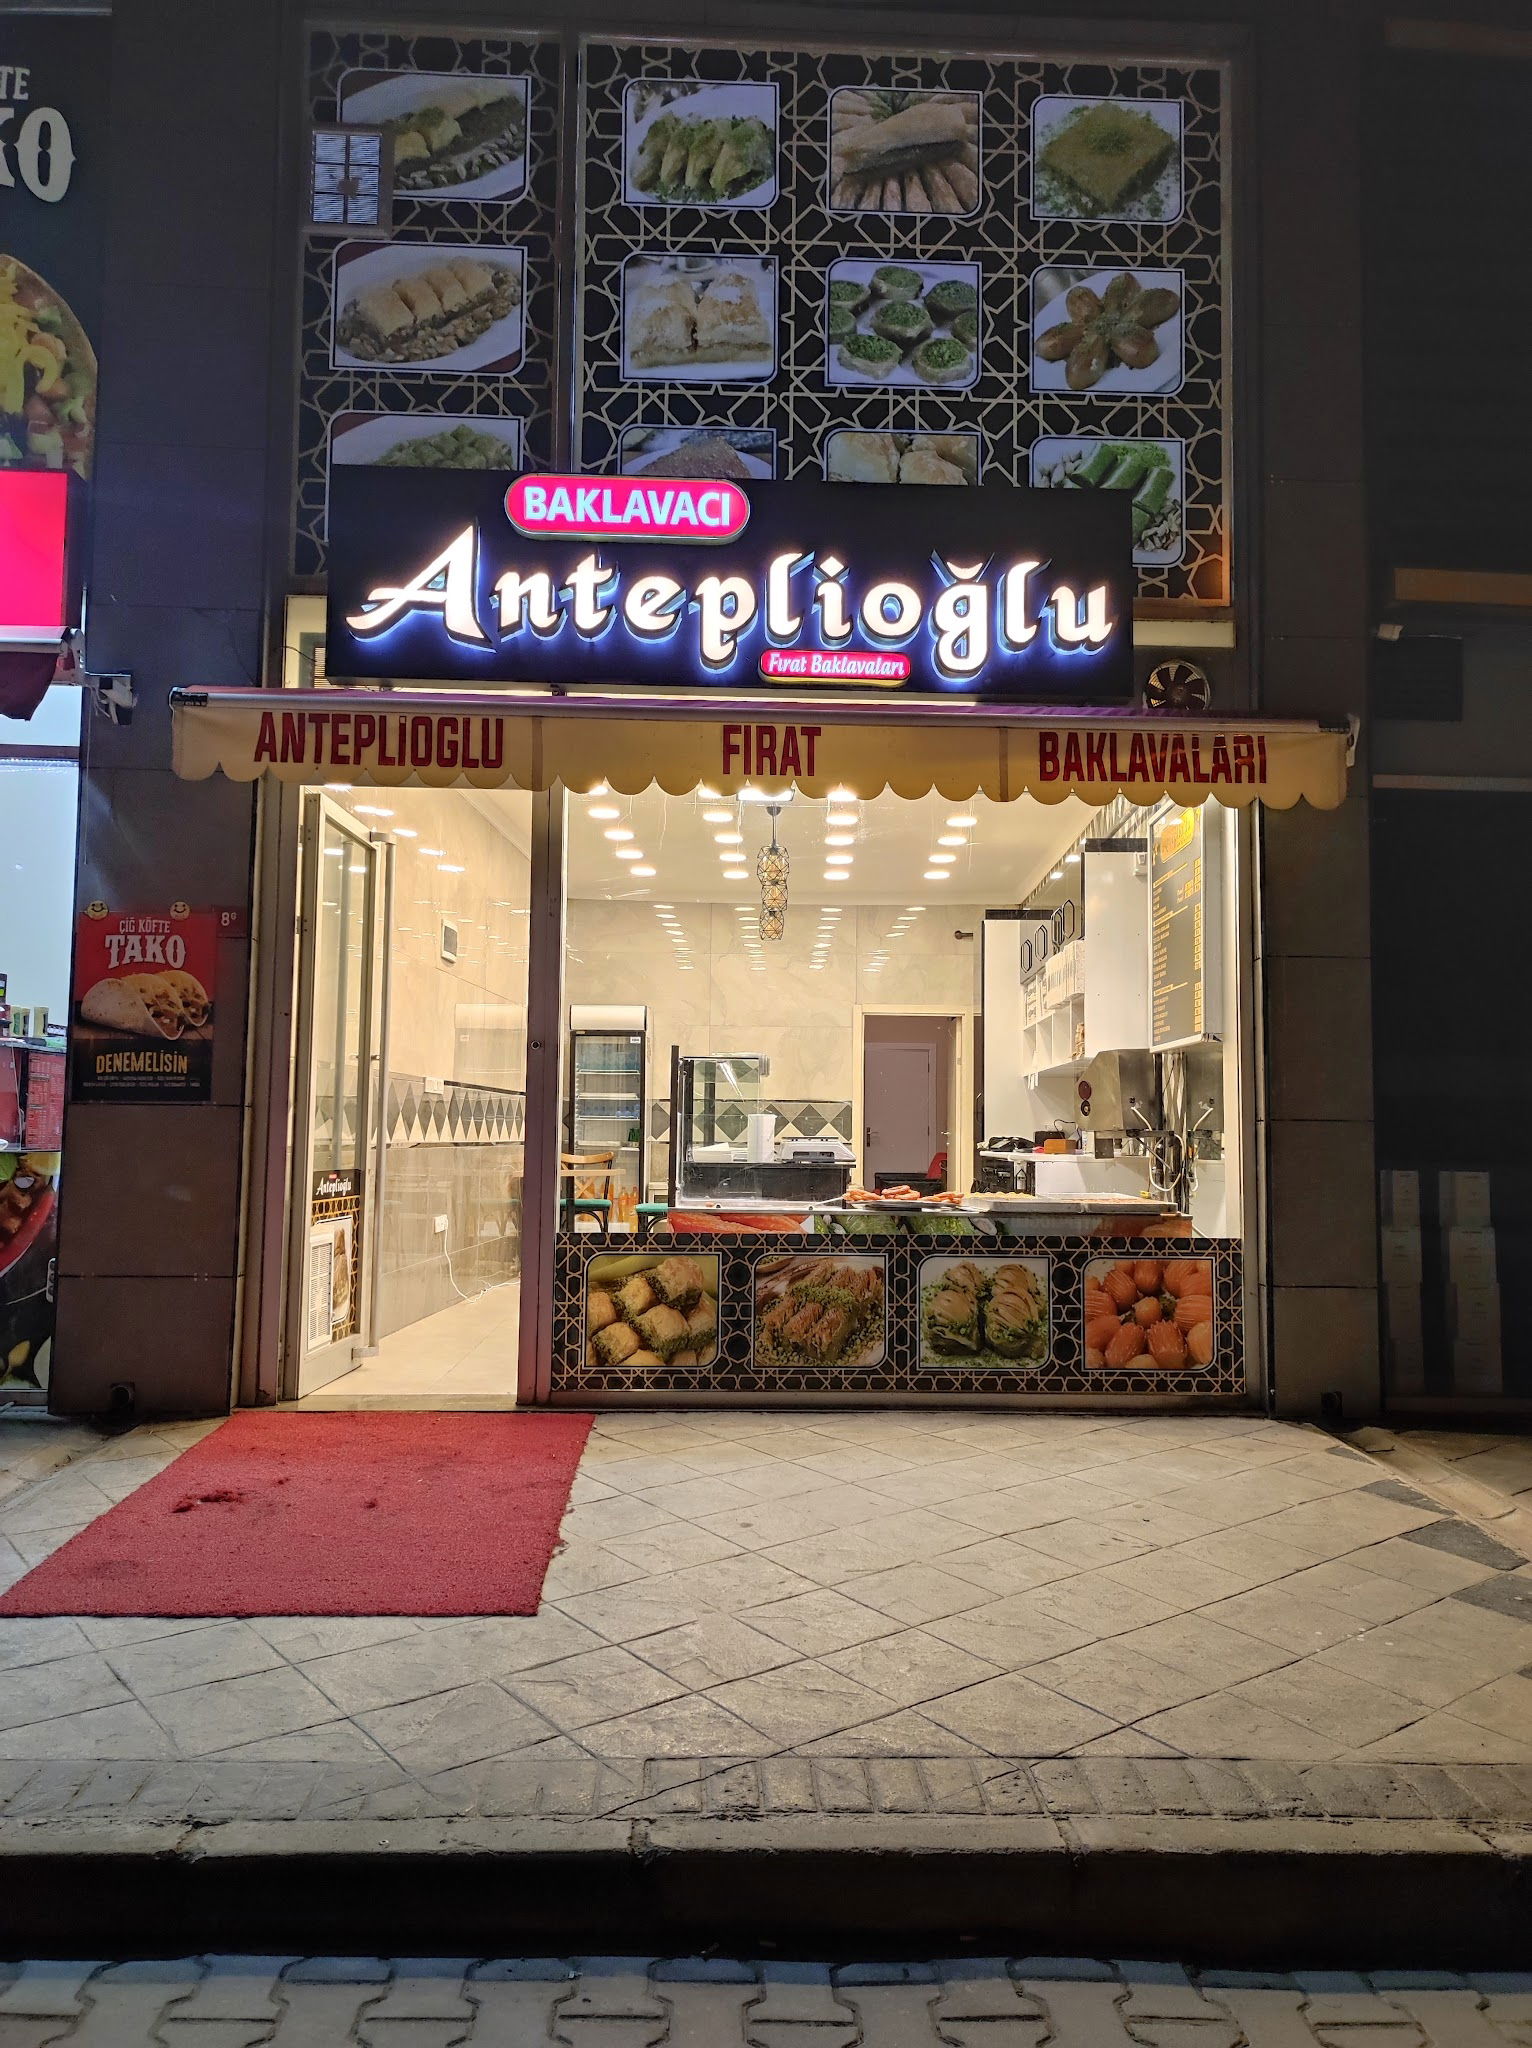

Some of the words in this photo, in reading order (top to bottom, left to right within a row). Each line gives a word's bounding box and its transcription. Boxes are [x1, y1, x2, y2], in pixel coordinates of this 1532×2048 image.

[523, 486, 731, 528] BAKLAVACI
[345, 524, 1113, 673] Anteplioğlu
[768, 652, 808, 673] Fırat
[811, 654, 905, 677] Baklavaları
[722, 724, 823, 777] FIRAT
[1039, 731, 1267, 784] BAKLAVALARI
[119, 917, 136, 934] ÇİĞ
[138, 917, 171, 933] KÖFTE
[104, 934, 187, 970] TAKO
[95, 1049, 189, 1073] DENEMELİSİN
